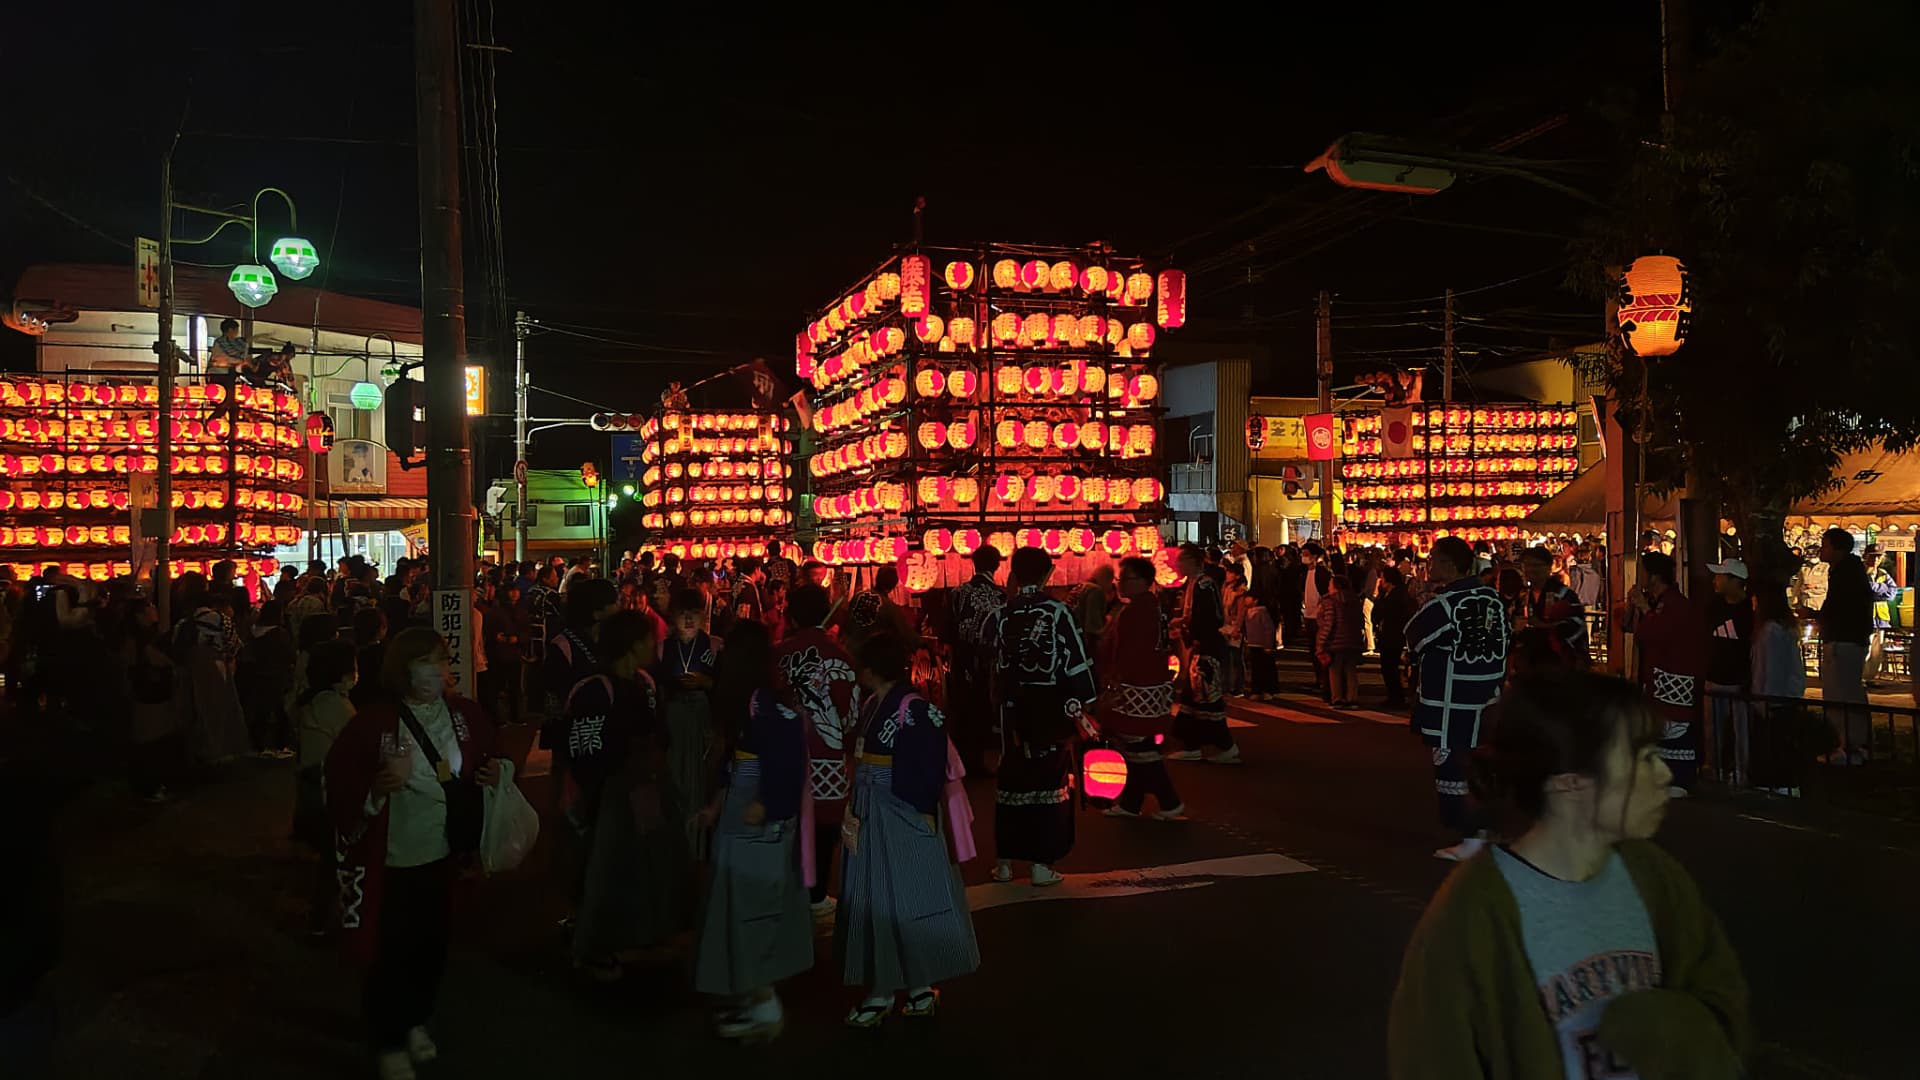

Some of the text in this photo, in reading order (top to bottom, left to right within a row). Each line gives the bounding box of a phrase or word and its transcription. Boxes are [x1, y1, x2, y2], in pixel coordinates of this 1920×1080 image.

[441, 593, 462, 688] 防犯カメラ
